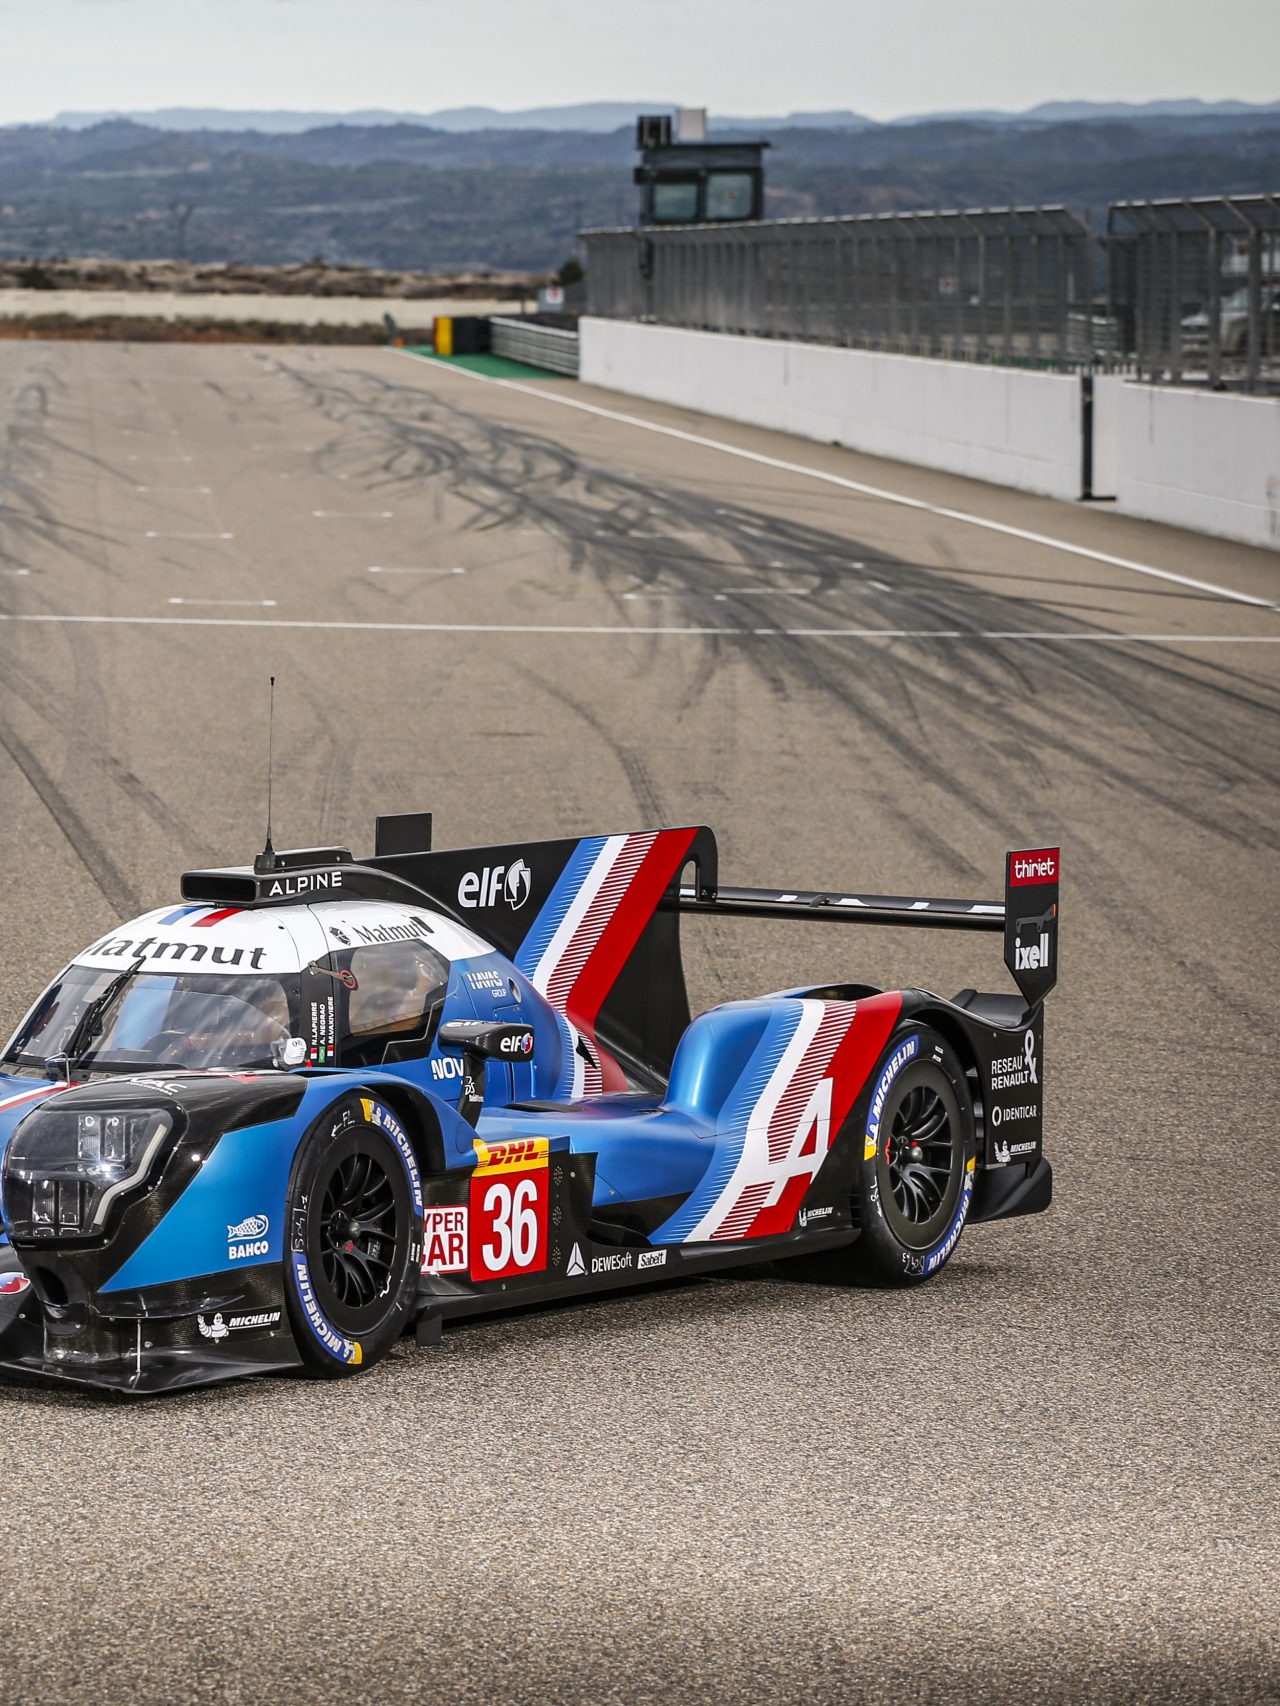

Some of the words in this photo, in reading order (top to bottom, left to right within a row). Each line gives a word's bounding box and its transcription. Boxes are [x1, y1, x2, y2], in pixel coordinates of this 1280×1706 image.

[1015, 857, 1055, 878] thiriet
[269, 871, 343, 897] ALPINE
[458, 865, 505, 908] elf
[352, 919, 429, 945] Matmut
[1015, 932, 1049, 971] ixell
[467, 970, 503, 990] HAVAS
[500, 1035, 521, 1053] elf
[991, 1055, 1023, 1075] RESEAU
[872, 1041, 915, 1120] MICHELIN
[991, 1070, 1030, 1091] RENAULT
[1003, 1105, 1037, 1122] IDENTICAR
[487, 1140, 540, 1167] DHL
[1010, 1141, 1037, 1153] MICHELIN
[383, 1114, 423, 1207] MICHELIN
[424, 1211, 464, 1232] YPER
[807, 1206, 834, 1217] MICHELIN
[482, 1179, 538, 1272] 36
[228, 1240, 269, 1260] BAHCO
[422, 1233, 464, 1267] AR
[641, 1251, 664, 1268] Sabelt
[591, 1254, 633, 1274] DEWESoft
[296, 1264, 342, 1353] MICHELIN
[229, 1312, 281, 1327] MICHELIN
